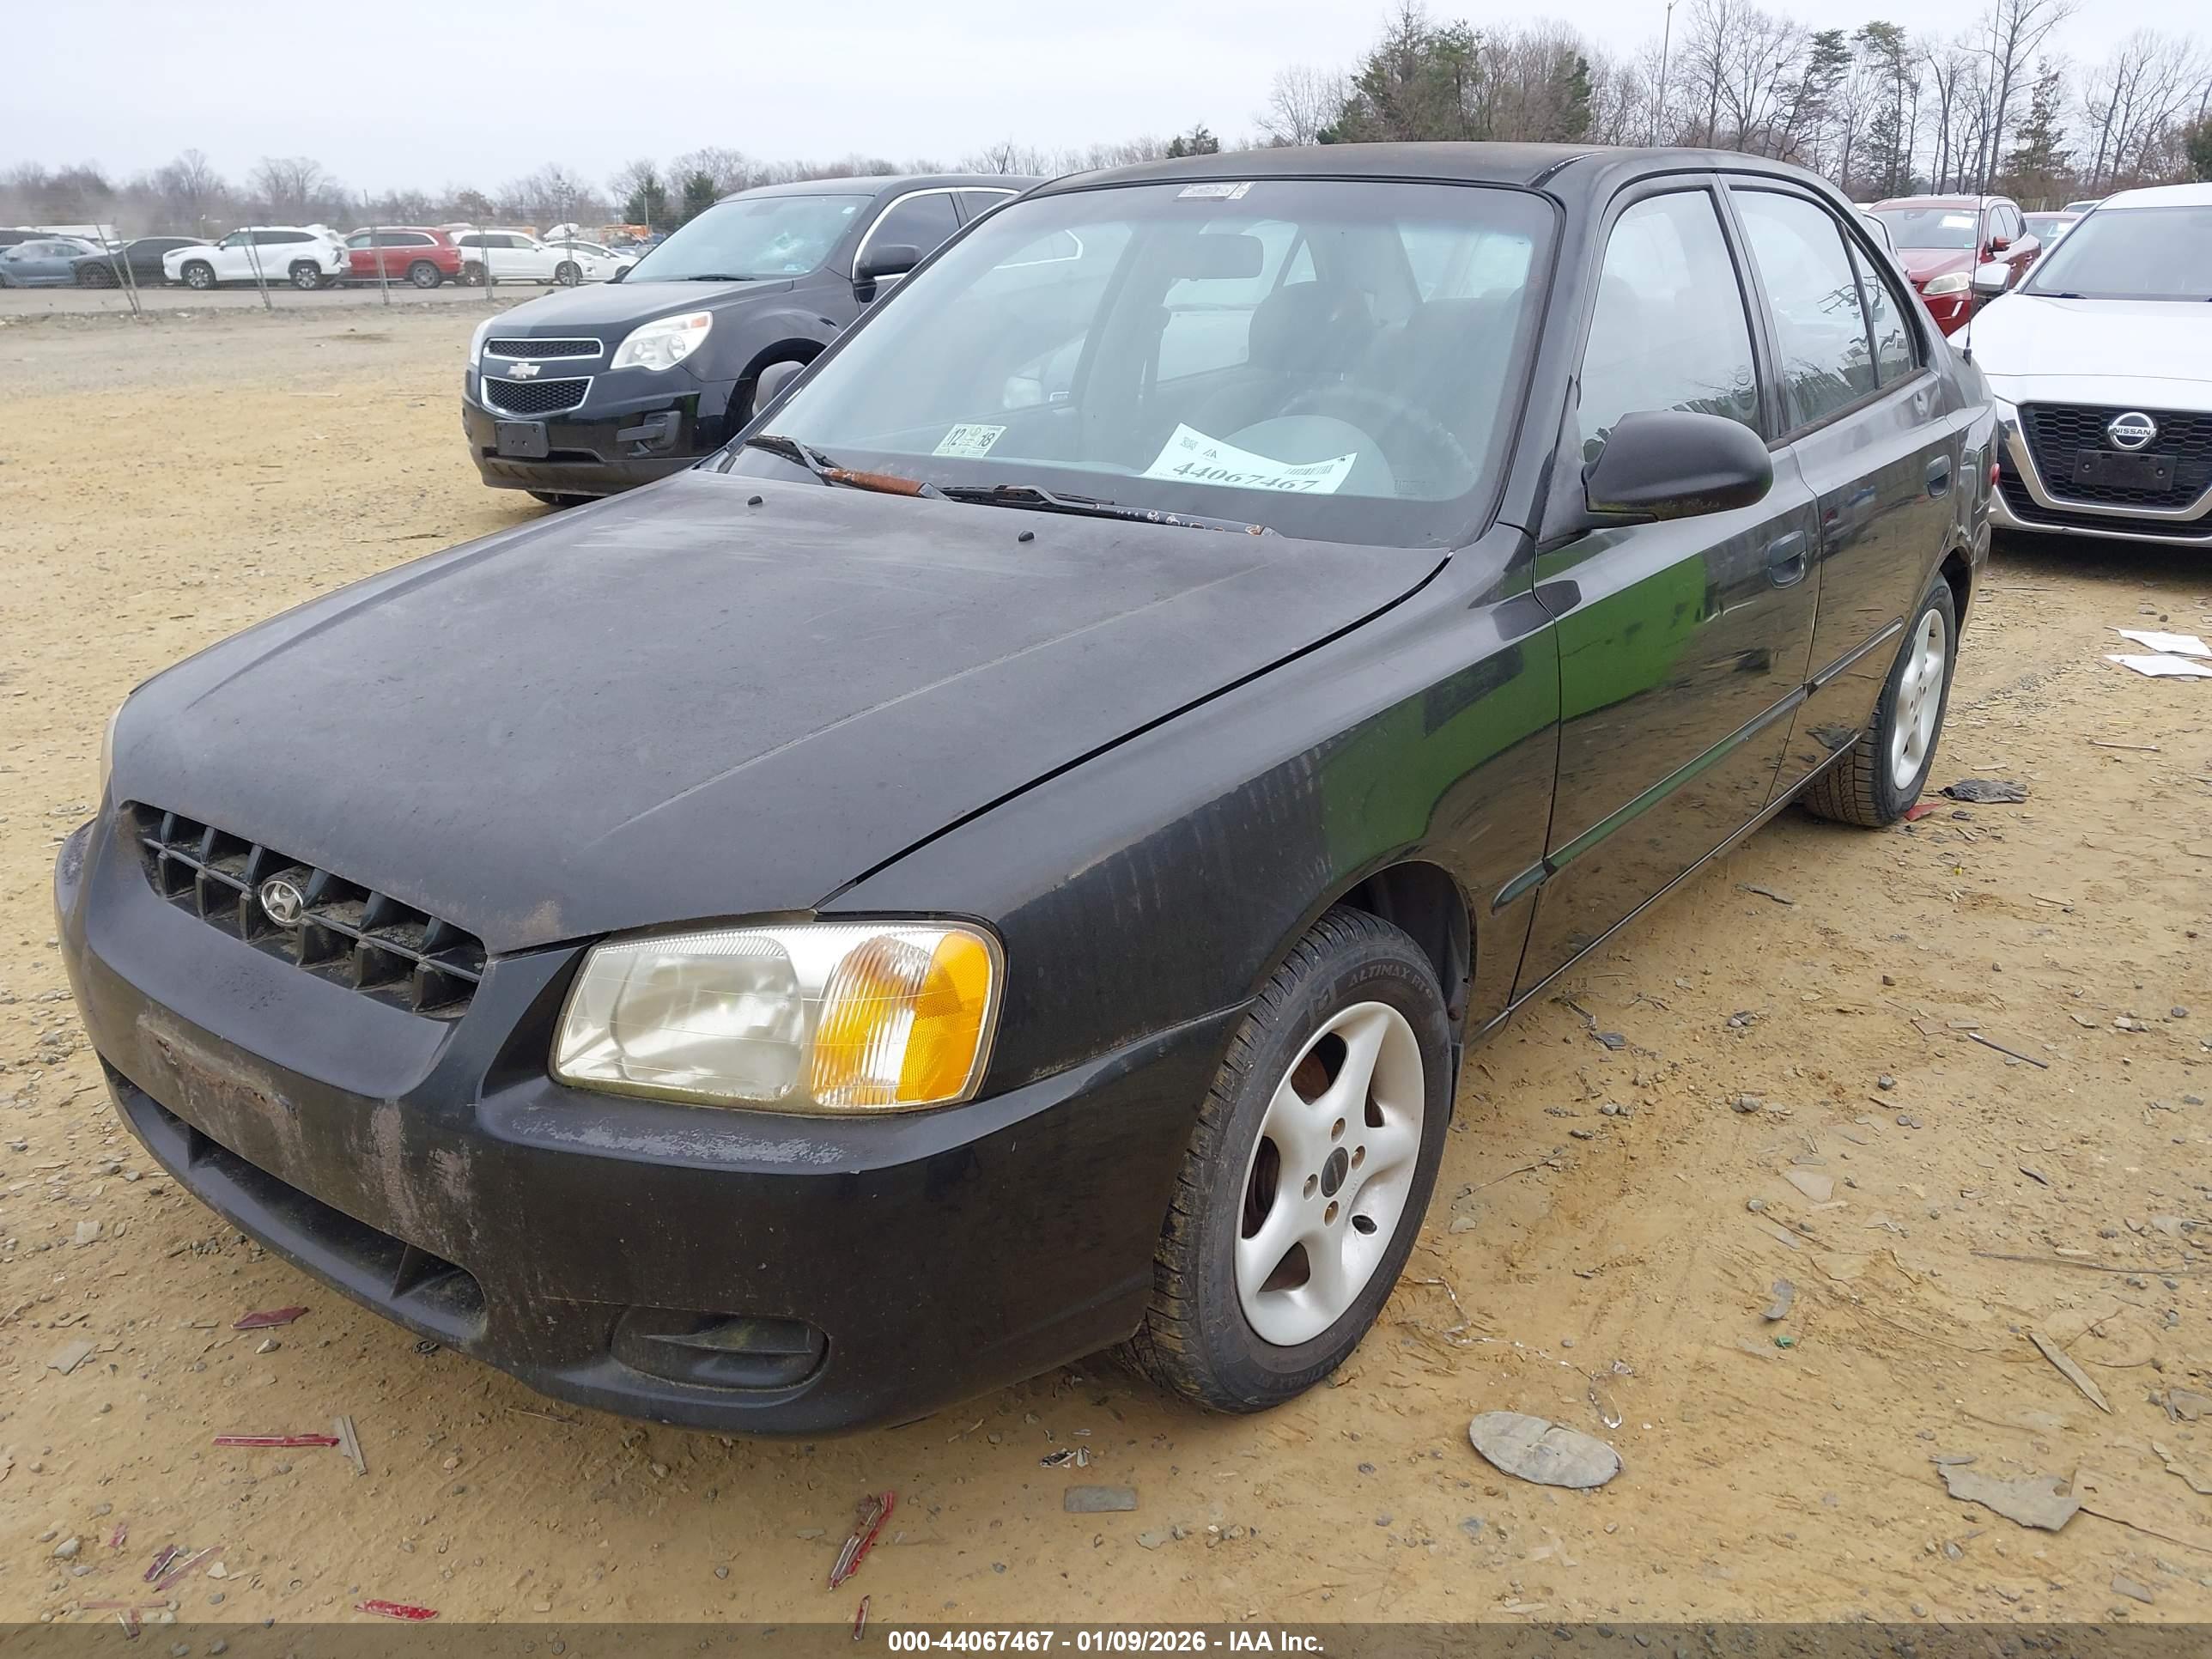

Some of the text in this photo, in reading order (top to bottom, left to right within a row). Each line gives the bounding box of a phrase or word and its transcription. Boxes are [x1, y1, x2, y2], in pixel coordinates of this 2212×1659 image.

[947, 428, 967, 446] 12
[978, 432, 996, 447] 18
[2113, 427, 2151, 435] NISSAN
[1172, 462, 1320, 492] 44067467
[1348, 964, 1410, 987] ALTIMAX
